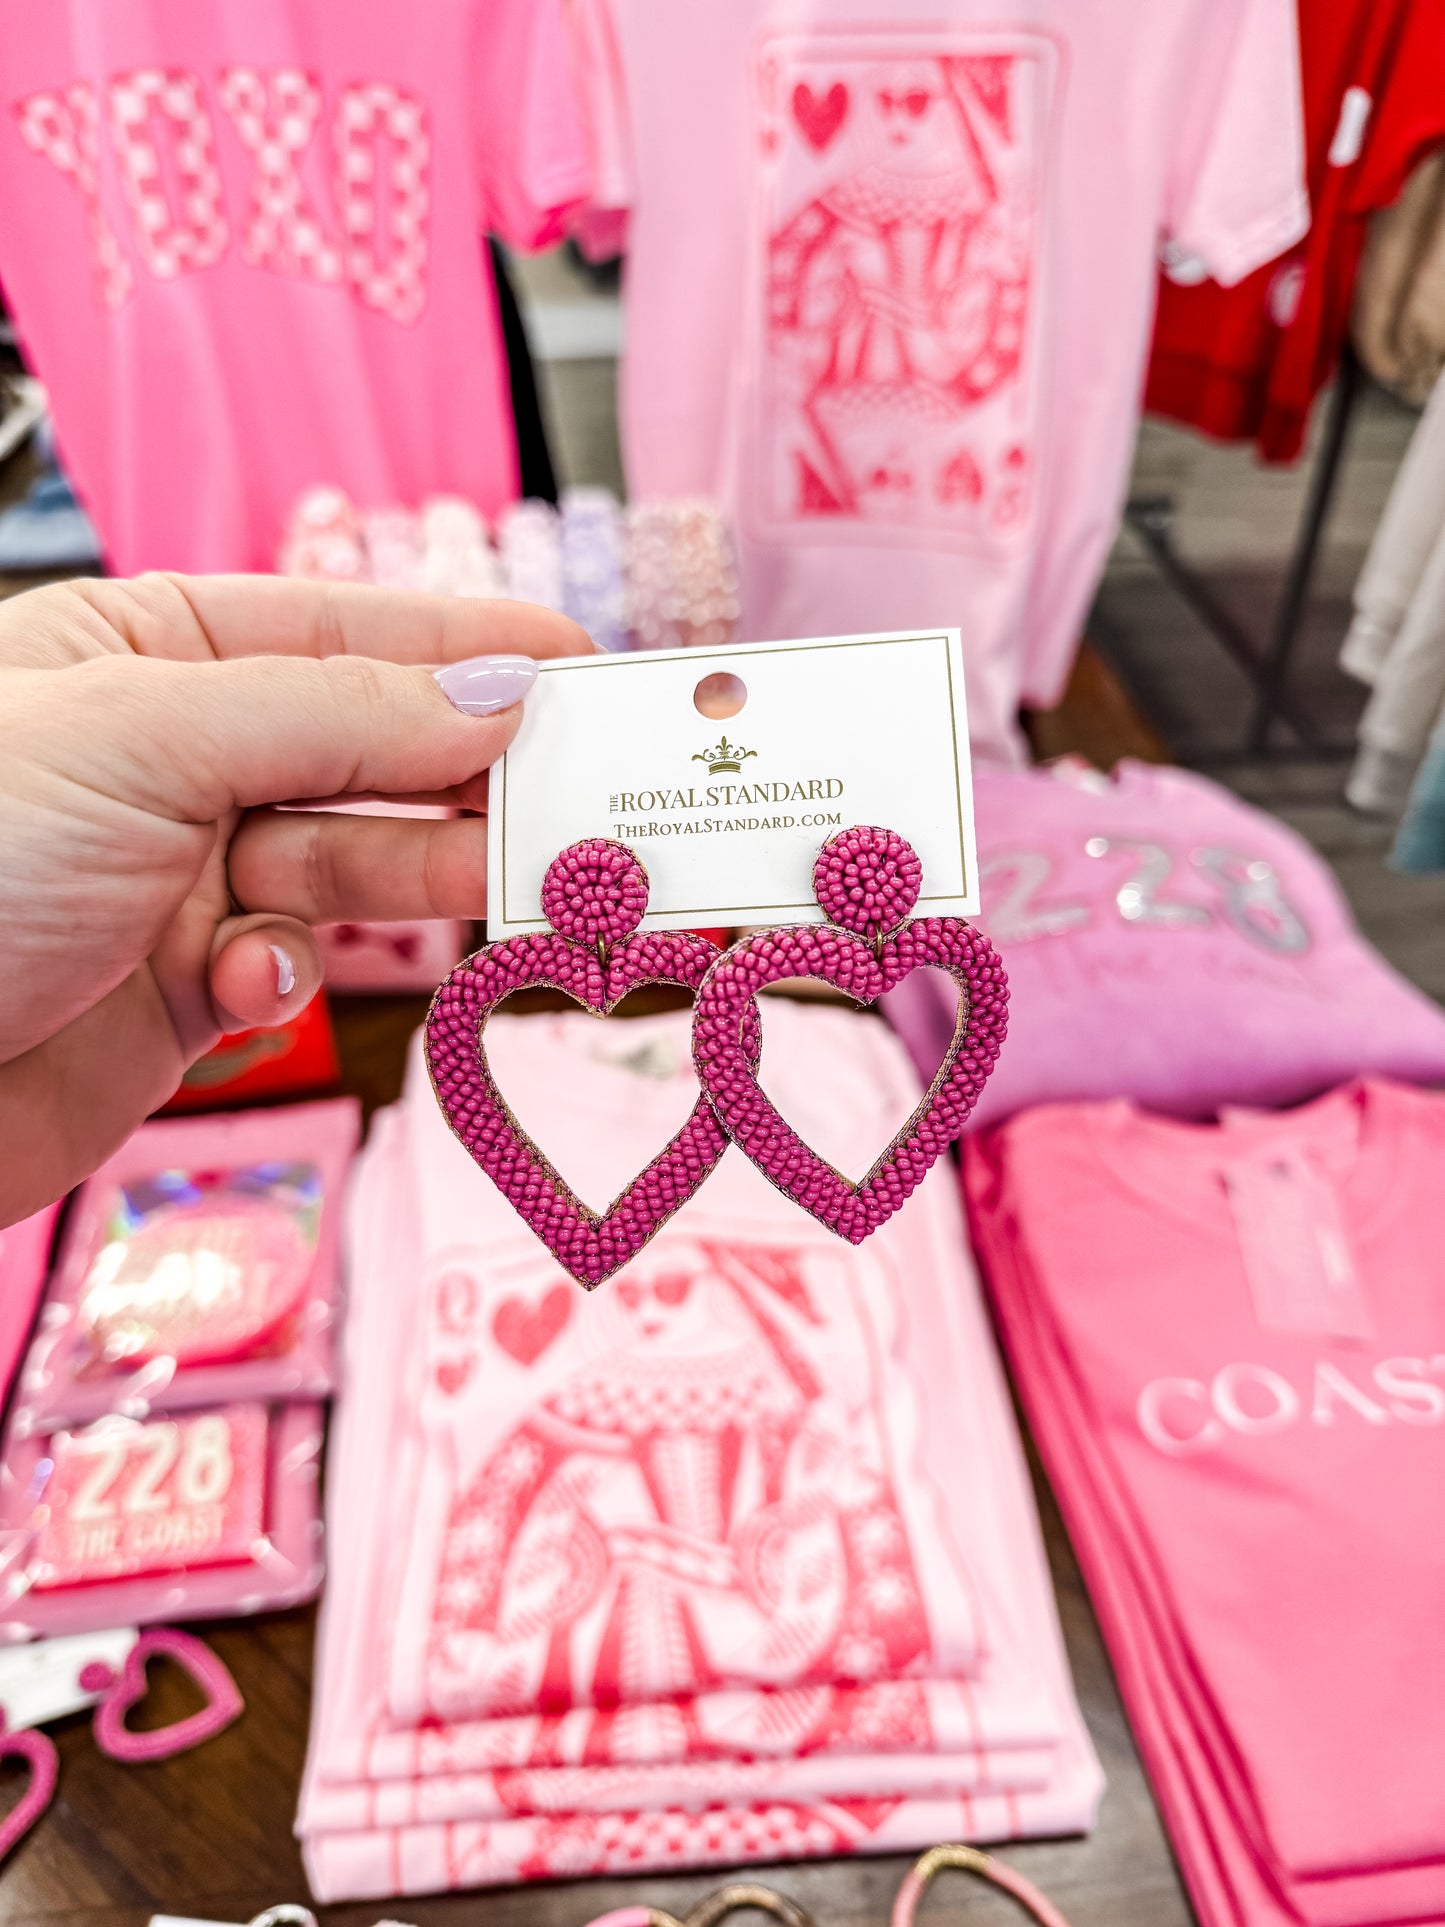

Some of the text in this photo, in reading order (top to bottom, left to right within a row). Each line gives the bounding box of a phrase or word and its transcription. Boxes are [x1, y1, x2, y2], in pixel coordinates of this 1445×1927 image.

[610, 778, 845, 814] THE ROYAL STANDARD
[978, 836, 1310, 955] 228
[1135, 1354, 1445, 1458] COAS
[70, 1414, 234, 1521] 228
